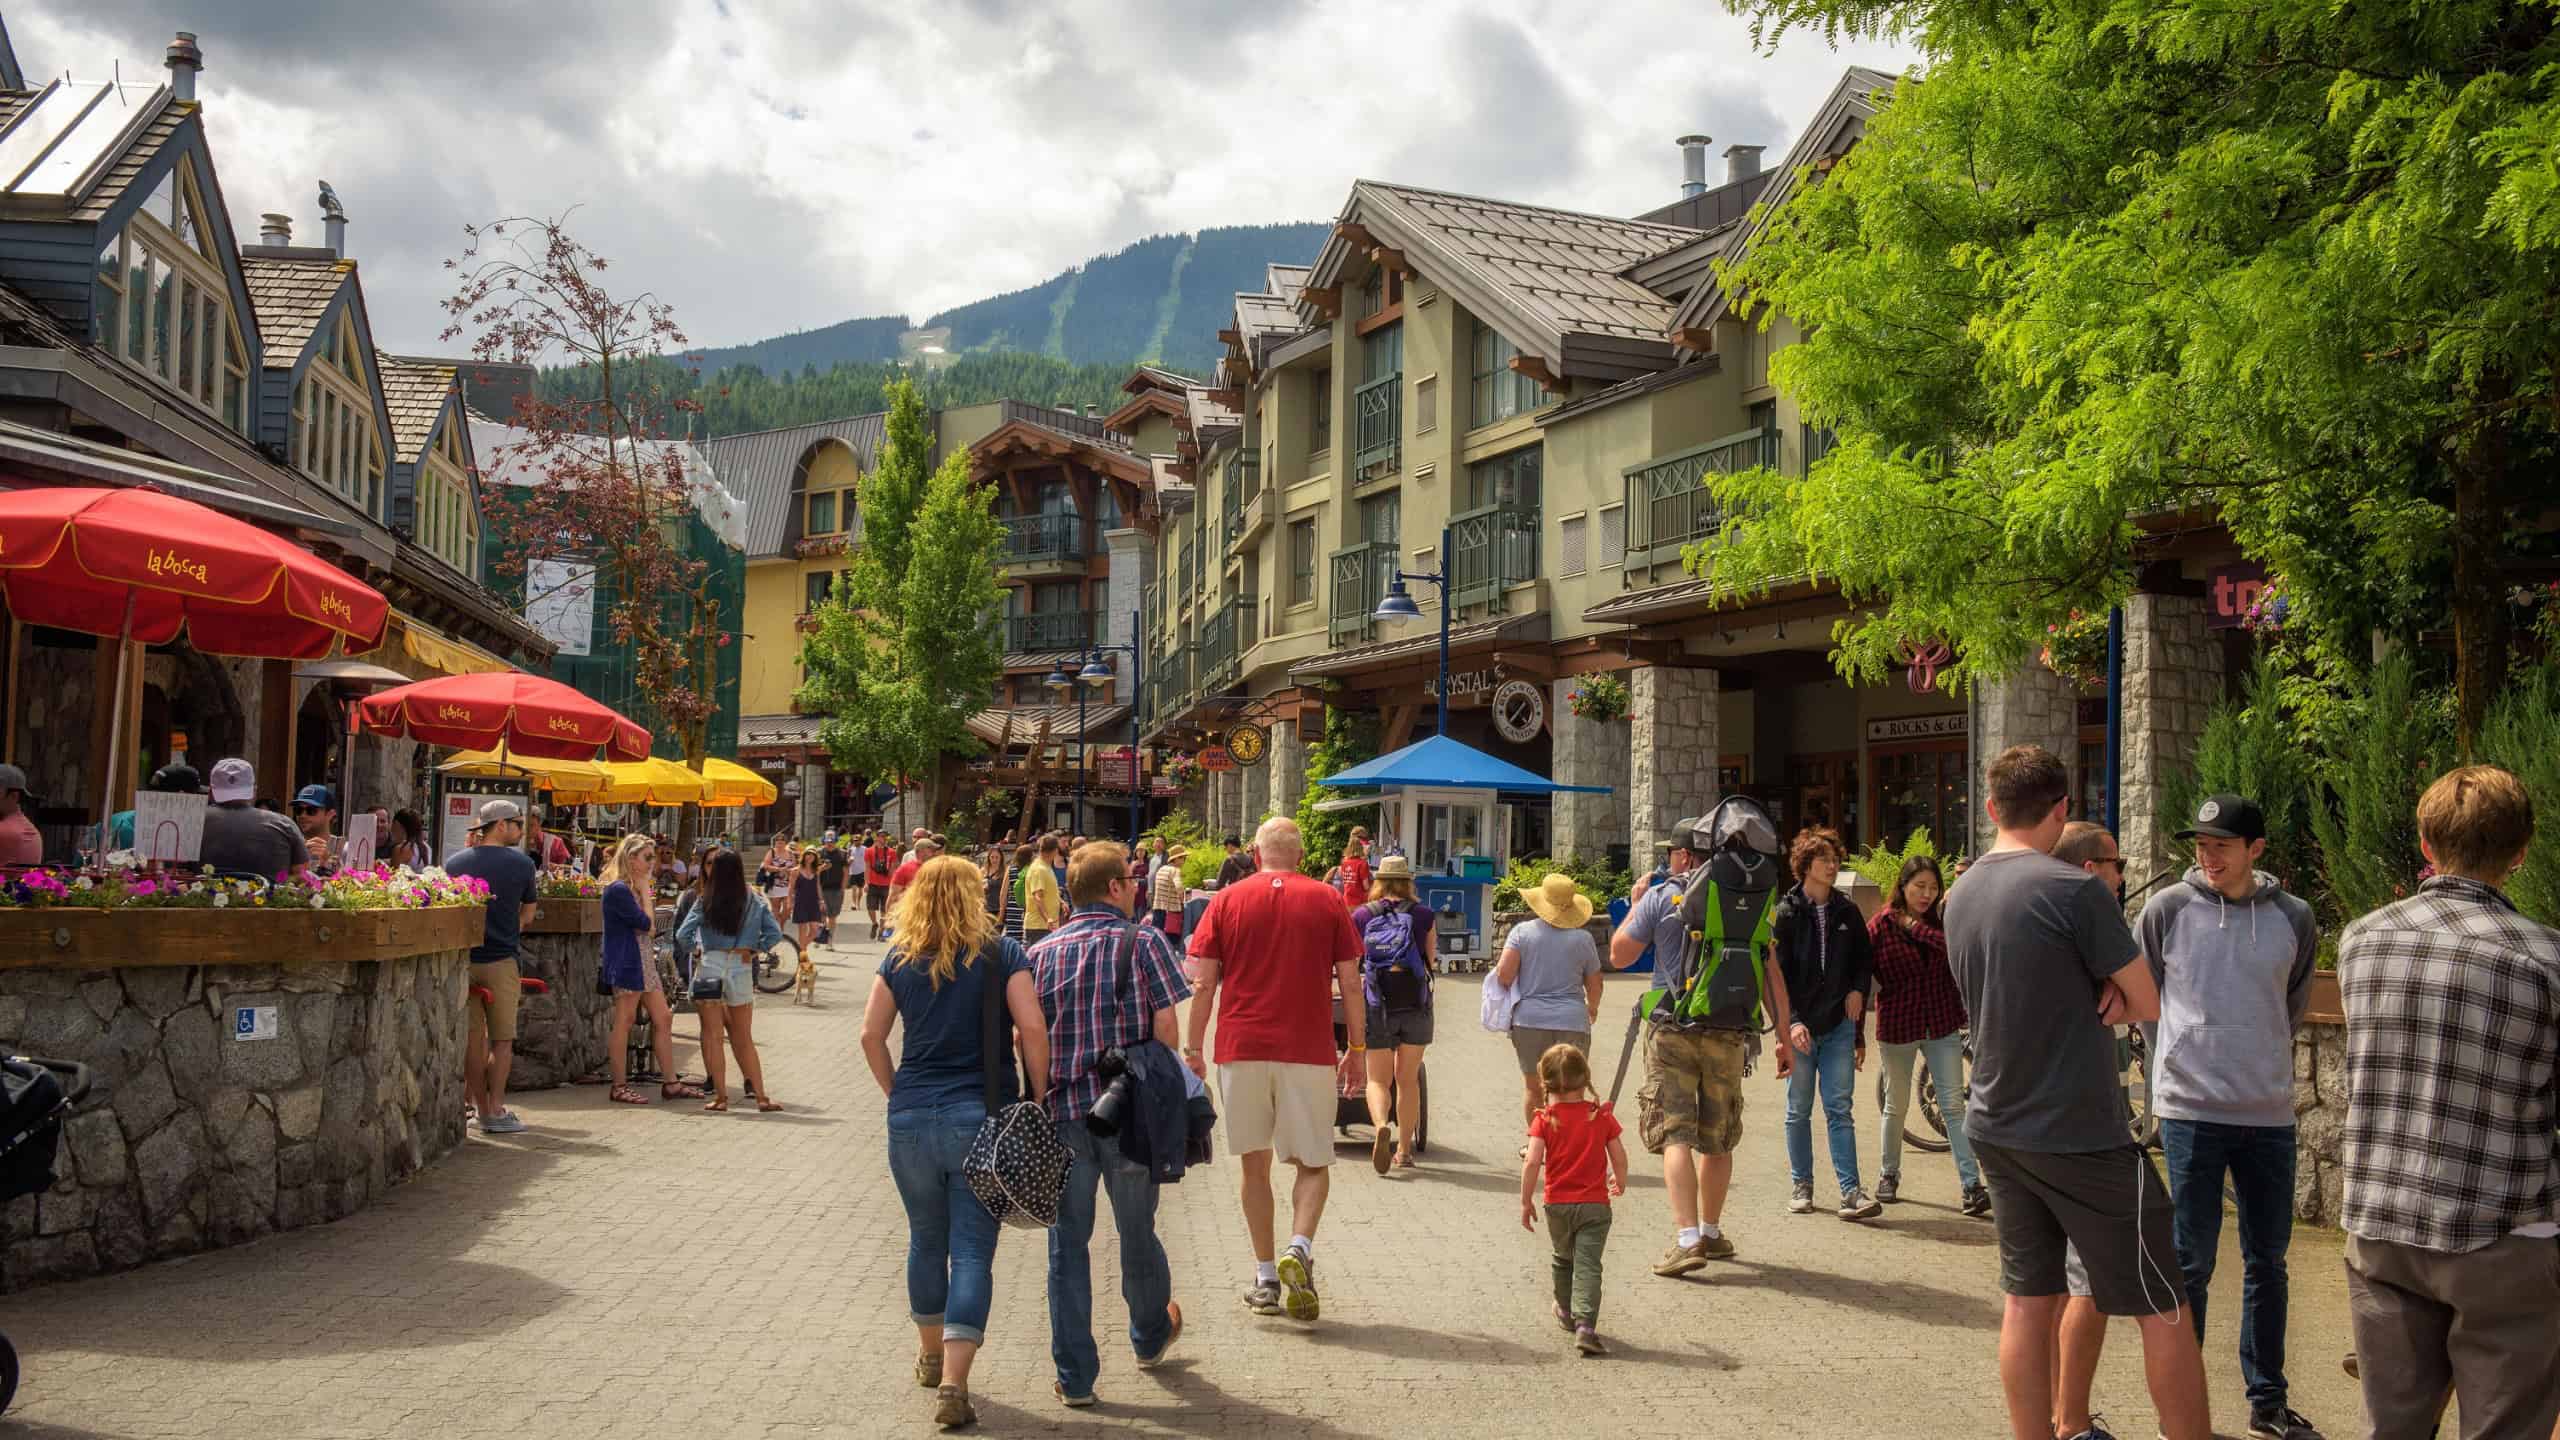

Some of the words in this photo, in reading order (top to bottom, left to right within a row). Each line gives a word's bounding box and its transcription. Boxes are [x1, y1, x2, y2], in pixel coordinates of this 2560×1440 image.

[1889, 720, 1929, 736] ROCKS
[1934, 718, 1944, 731] &
[1948, 716, 1968, 730] GE
[761, 759, 785, 769] Roots
